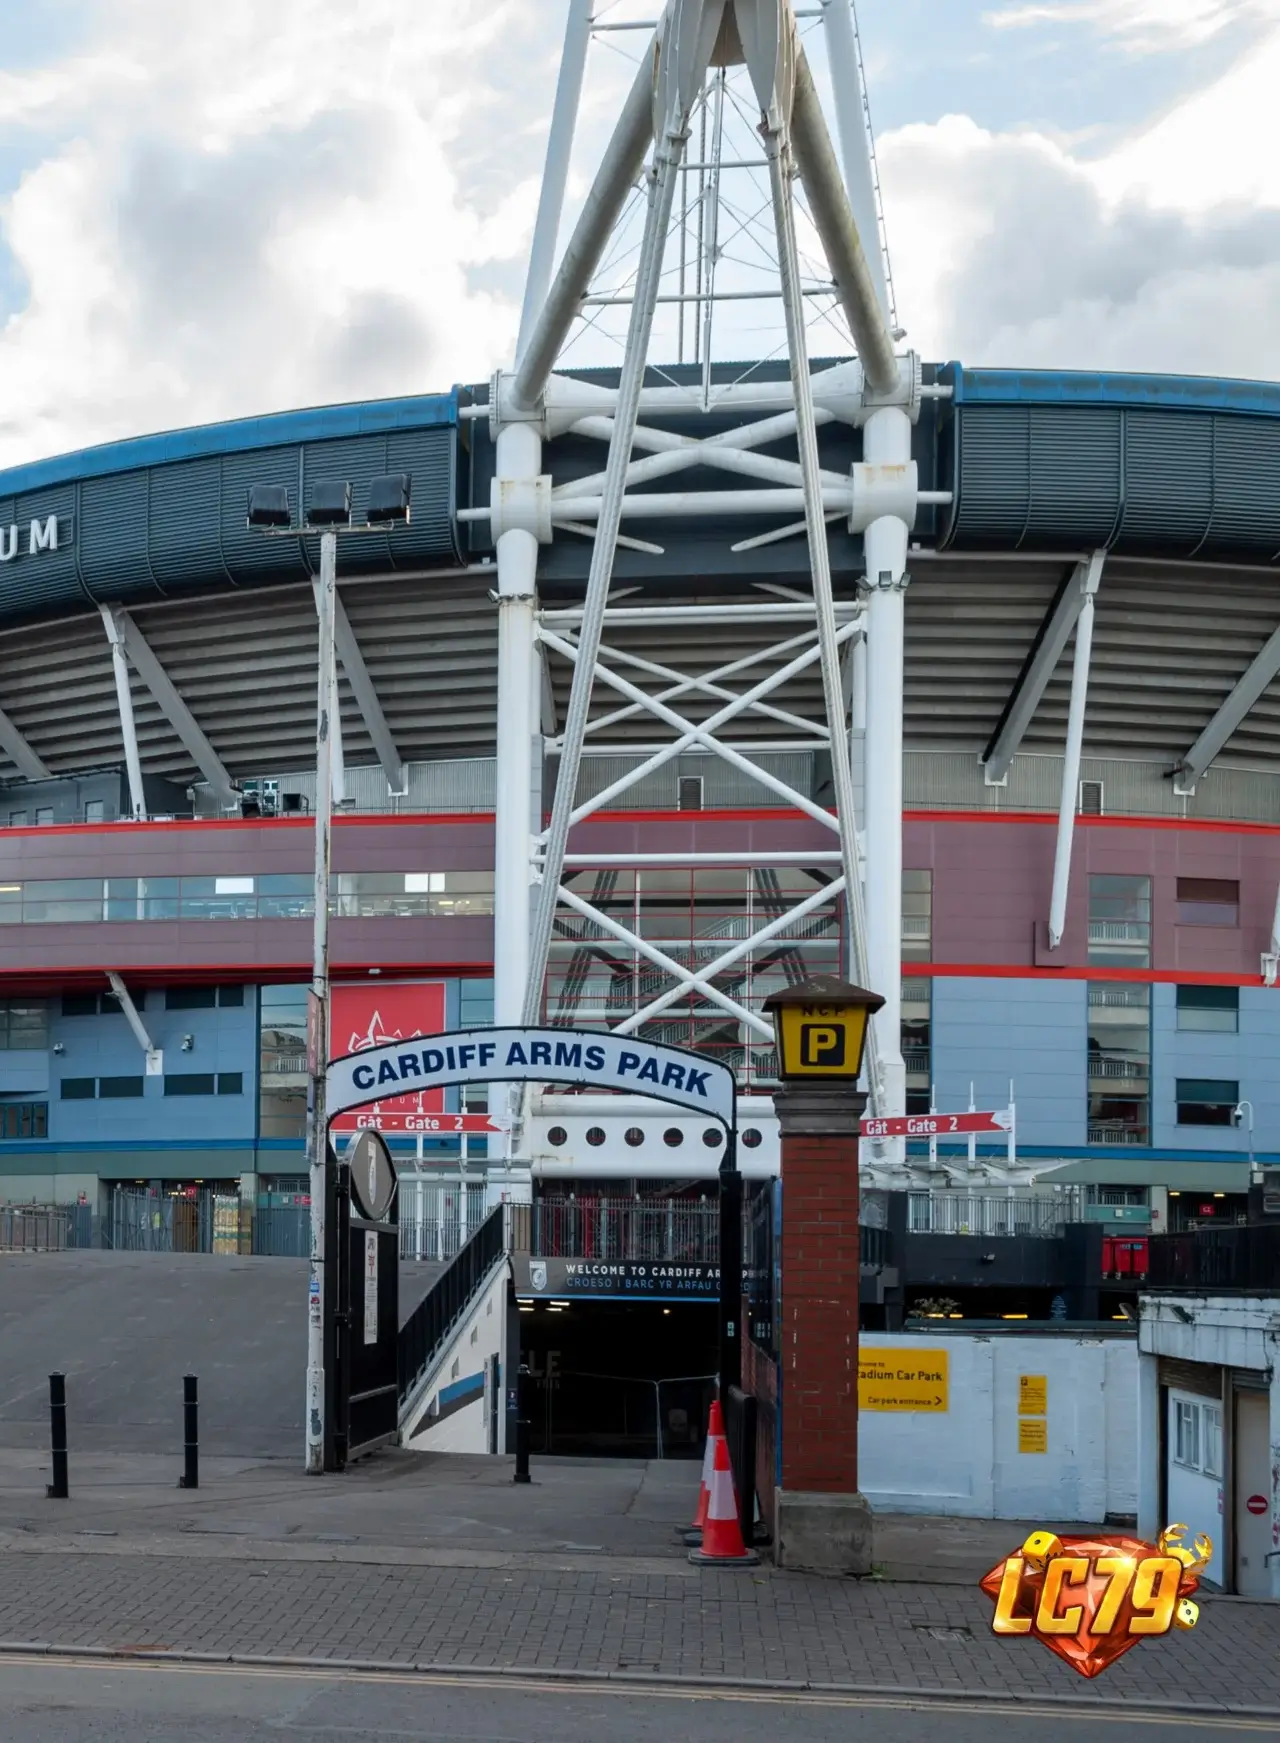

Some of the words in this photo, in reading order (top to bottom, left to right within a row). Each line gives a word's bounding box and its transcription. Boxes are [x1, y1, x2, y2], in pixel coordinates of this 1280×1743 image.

[808, 1028, 837, 1063] P
[352, 1042, 497, 1090] CARDIFF
[505, 1041, 606, 1071] ARMS
[616, 1051, 713, 1097] PARK
[405, 1116, 439, 1130] Gate
[454, 1116, 464, 1130] 2
[866, 1120, 888, 1135] Gât
[907, 1118, 937, 1133] Gate
[949, 1116, 958, 1131] 2
[566, 1264, 625, 1275] WELCOME
[631, 1266, 646, 1276] TO
[652, 1267, 702, 1277] CARDIFF
[566, 1277, 612, 1288] CROESO
[625, 1279, 654, 1289] BARC
[660, 1279, 672, 1289] YR
[677, 1280, 712, 1290] ARFAU
[896, 1370, 915, 1381] Car
[918, 1370, 942, 1381] Park
